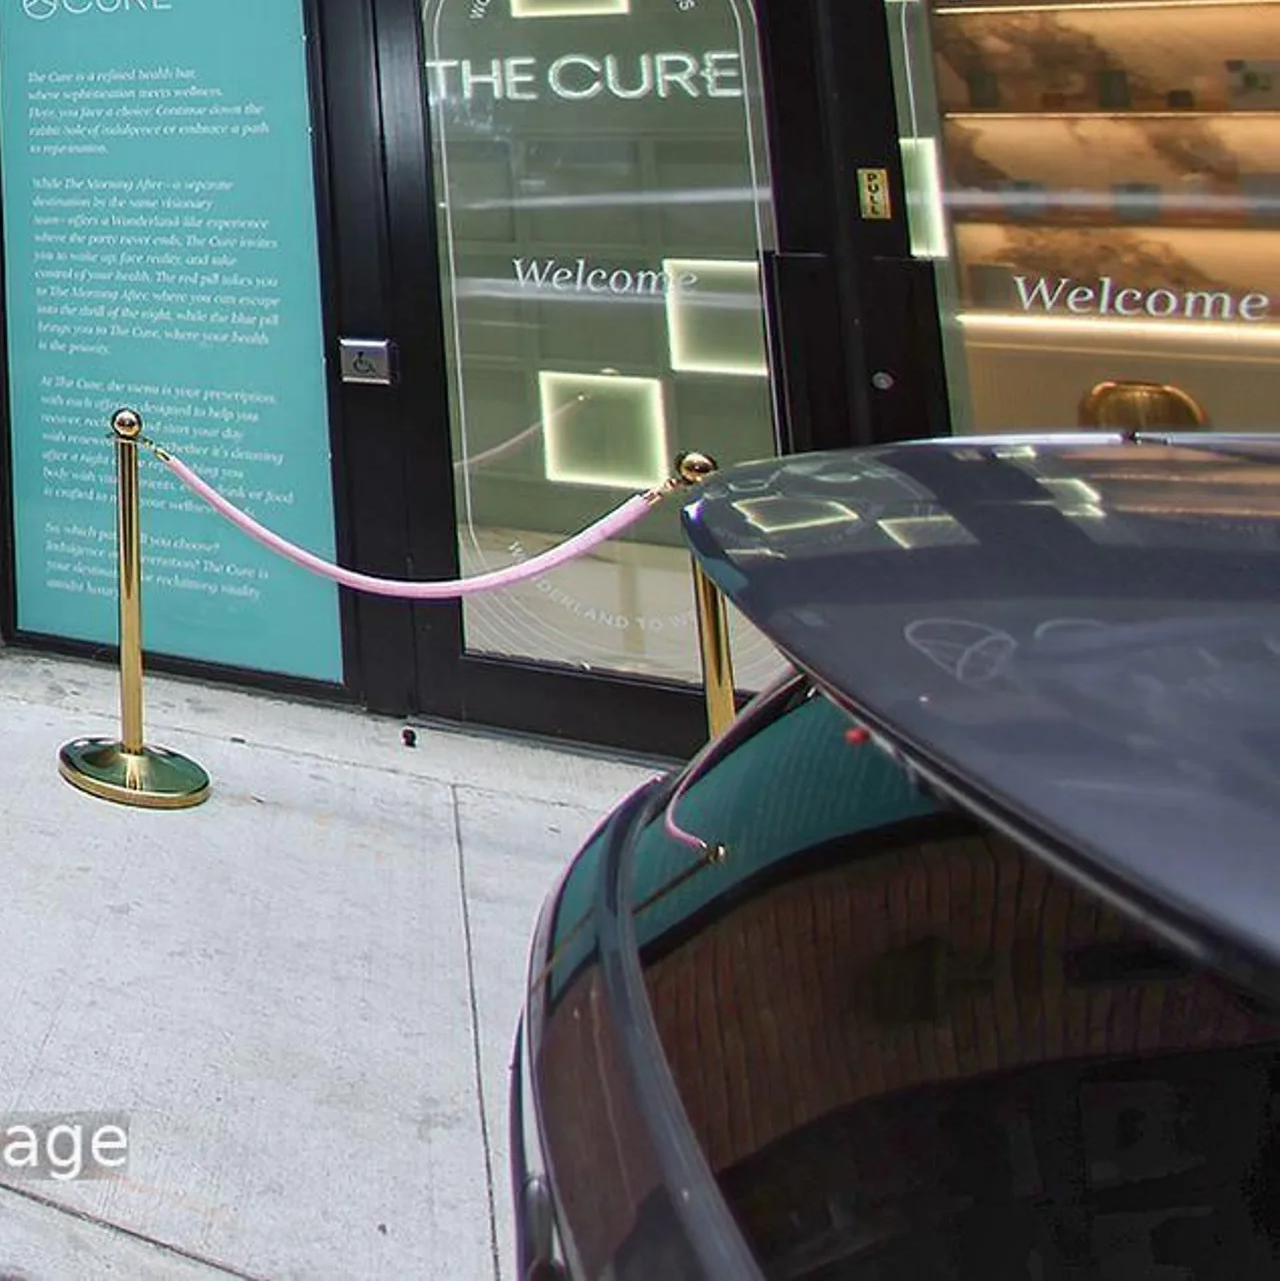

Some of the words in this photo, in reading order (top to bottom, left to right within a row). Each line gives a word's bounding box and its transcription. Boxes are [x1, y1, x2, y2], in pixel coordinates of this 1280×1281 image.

[425, 55, 538, 101] THE
[547, 51, 744, 101] CURE
[867, 173, 880, 215] PULL
[513, 258, 700, 295] Welcome
[1013, 275, 1269, 320] Welcome
[508, 540, 629, 630] WDERLAND
